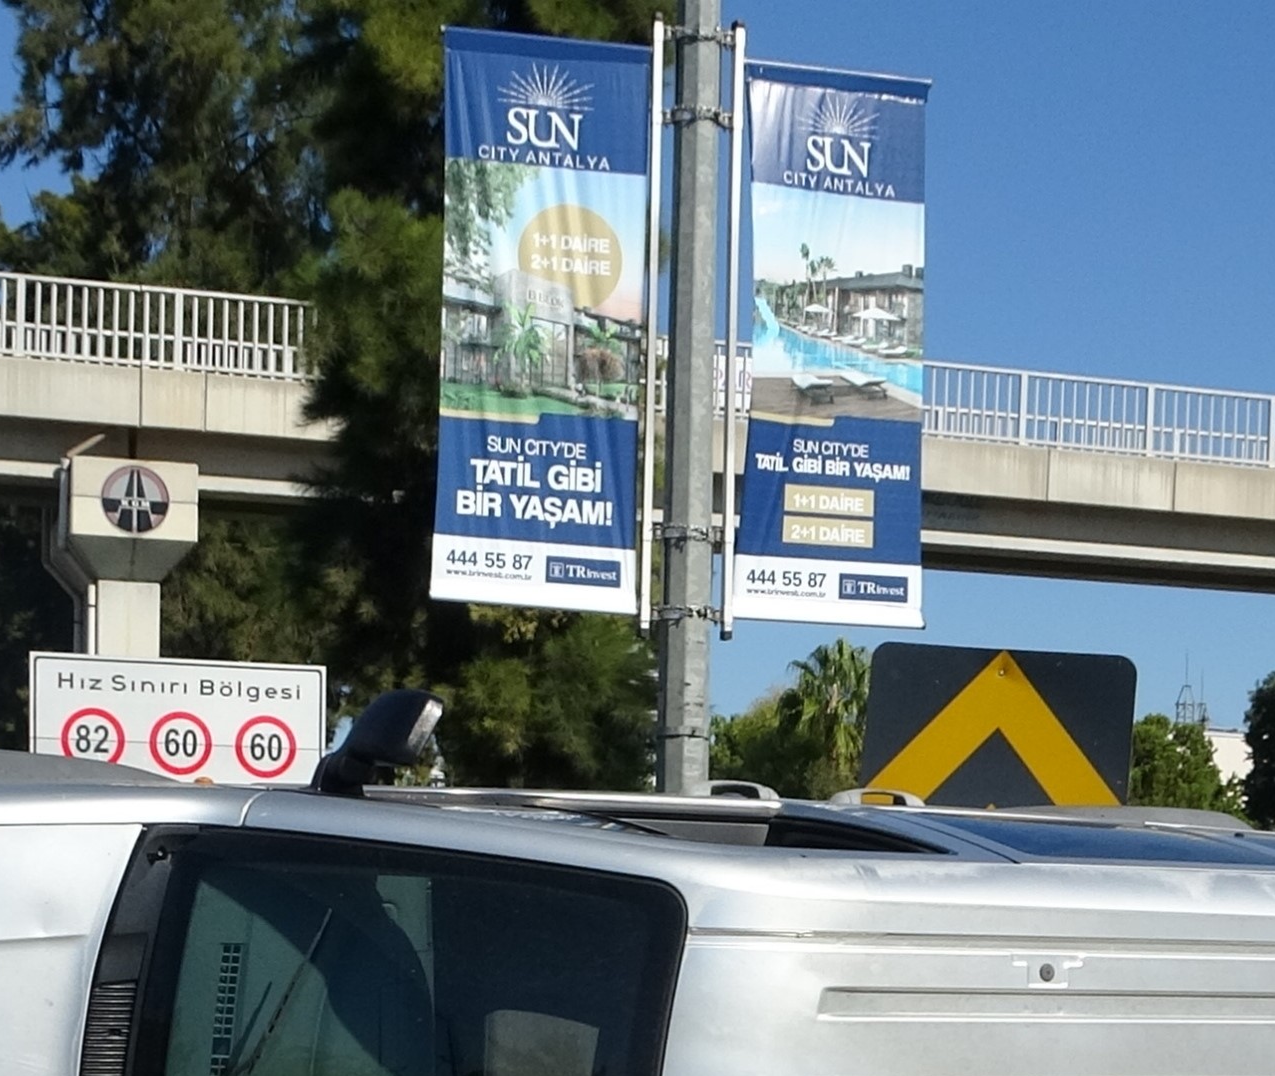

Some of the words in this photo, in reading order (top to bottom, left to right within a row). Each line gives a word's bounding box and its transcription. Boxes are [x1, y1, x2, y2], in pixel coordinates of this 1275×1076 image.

[506, 107, 583, 151] SUN
[478, 145, 520, 161] CITY
[526, 150, 610, 170] ANTALYA
[806, 135, 871, 178] SUN
[783, 170, 817, 188] CITY
[824, 176, 895, 198] ANTALYA
[533, 232, 557, 249] 1+1
[561, 234, 611, 254] DAİRE
[531, 254, 558, 271] 2+1
[561, 256, 611, 276] DAİRE
[487, 435, 521, 454] SUN
[525, 438, 587, 460] CITY'DE
[793, 438, 819, 454] SUN
[470, 456, 540, 488] TATİL
[547, 460, 602, 493] GİBİ
[755, 452, 789, 472] TATİL
[792, 454, 822, 475] GİBİ
[825, 456, 850, 476] BİR
[853, 461, 911, 483] YAŞAM!
[456, 485, 502, 517] BİR
[509, 494, 613, 529] YAŞAM!
[793, 493, 815, 509] 1+1
[819, 493, 864, 512] DAİRE
[791, 524, 816, 540] 2+1
[819, 524, 865, 543] DAİRE
[446, 549, 478, 566] 444
[485, 552, 506, 569] 55
[512, 554, 533, 571] 87
[566, 564, 617, 581] TRinvest
[746, 569, 776, 585] 444
[782, 571, 802, 587] 55
[807, 572, 827, 588] 87
[857, 581, 904, 596] TRinvest
[57, 672, 102, 690] Hız
[111, 675, 188, 694] Sınırı
[199, 679, 301, 702] Bölgesi
[75, 724, 109, 753] 82
[164, 728, 198, 758] 60
[250, 732, 283, 762] 60
